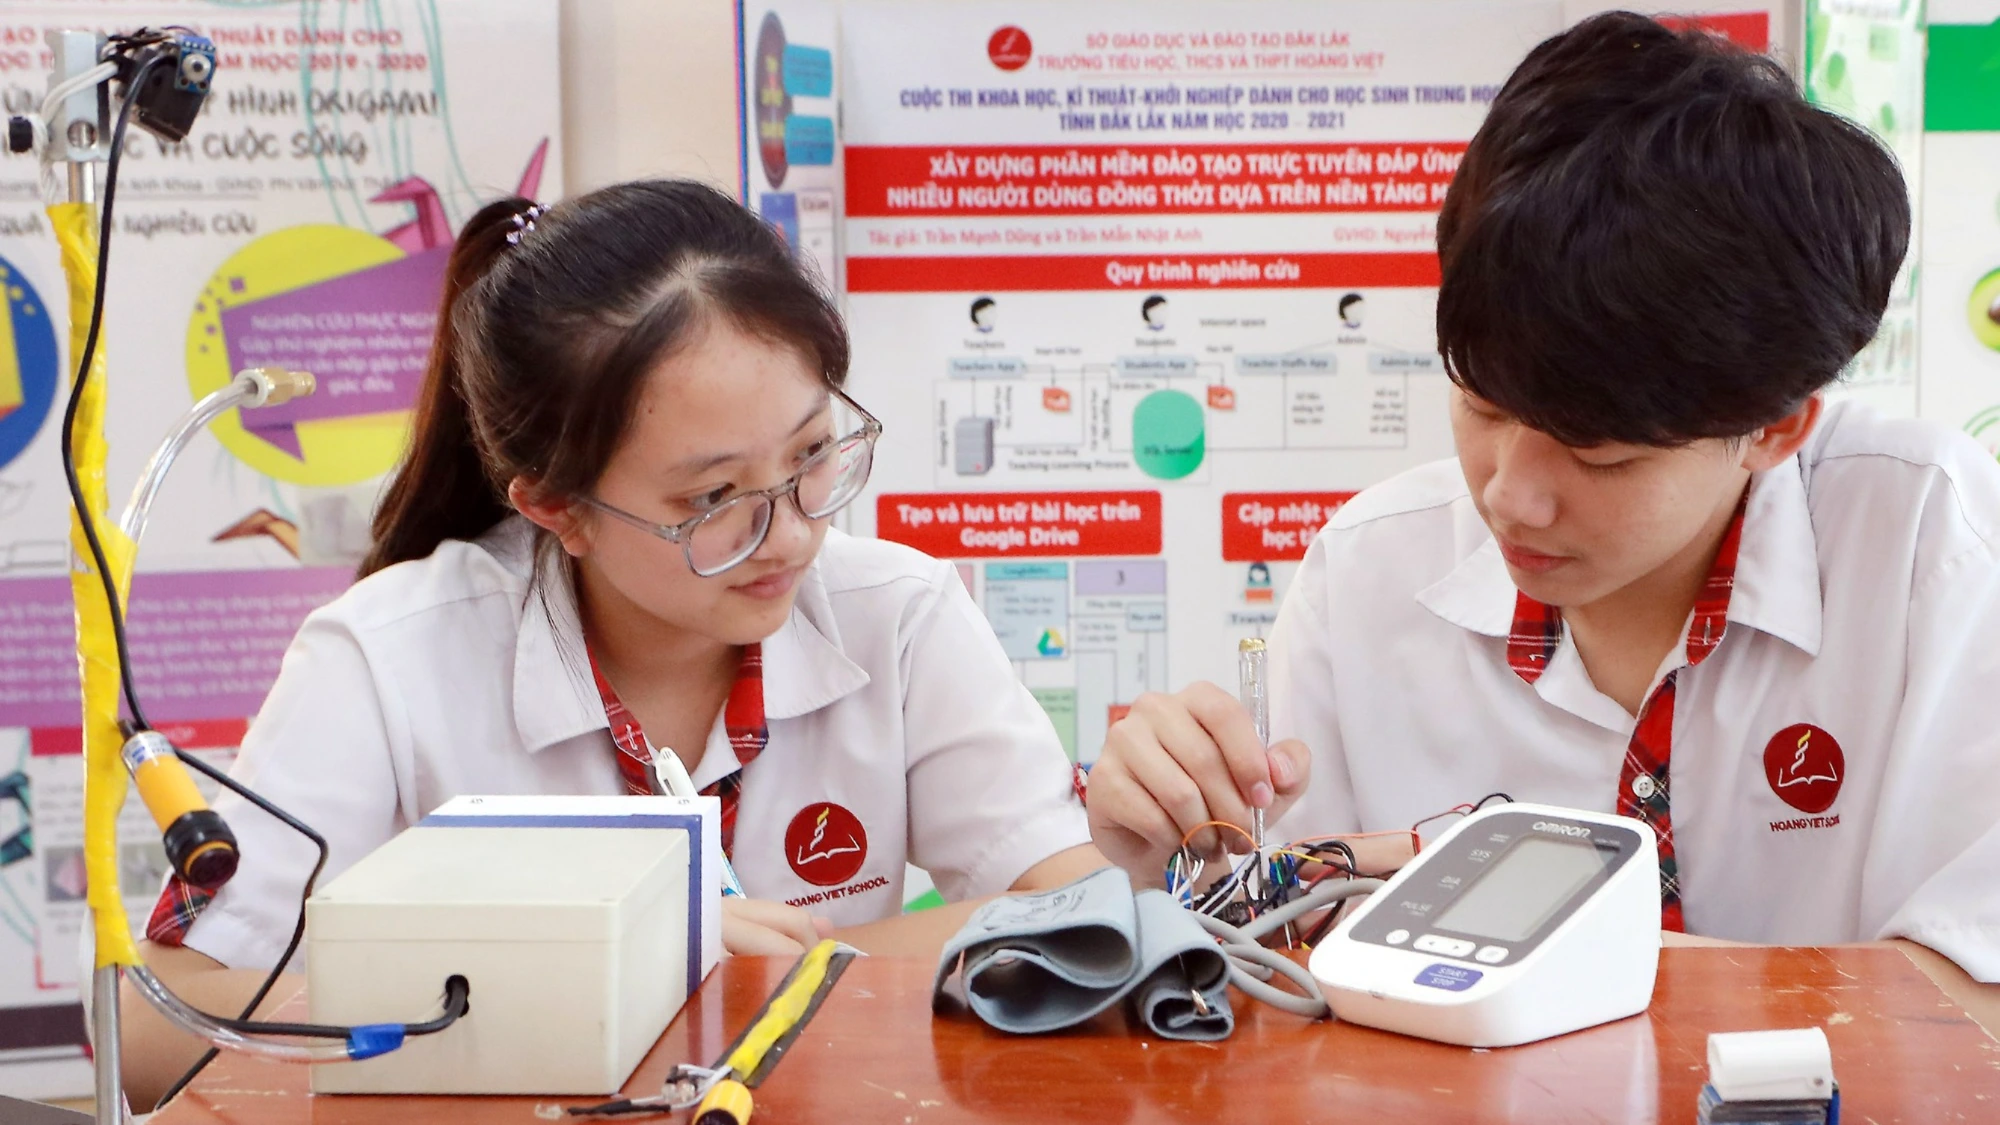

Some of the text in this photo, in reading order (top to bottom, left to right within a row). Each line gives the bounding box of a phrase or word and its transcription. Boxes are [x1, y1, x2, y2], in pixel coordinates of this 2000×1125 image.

[352, 28, 403, 45] CHO
[308, 52, 357, 71] 2019
[376, 52, 427, 71] 2020
[1186, 53, 1224, 69] THCS
[1254, 53, 1290, 68] THPT
[949, 89, 972, 106] THI
[978, 89, 1019, 106] KHOA
[1299, 86, 1329, 104] CHO
[1371, 86, 1409, 103] SINH
[1415, 85, 1466, 103] TRUNG
[1251, 112, 1289, 129] 2020
[1308, 111, 1344, 129] 2021
[929, 150, 970, 178] XÂY
[975, 153, 1035, 182] DỰNG
[1040, 149, 1096, 177] PHẦN
[1101, 148, 1149, 177] MỀM
[1152, 148, 1198, 176] ĐÀO
[1201, 153, 1243, 180] TẠO
[1247, 151, 1302, 179] TRỰC
[1305, 147, 1373, 175] TUYẾN
[1376, 147, 1419, 174] ĐÁP
[887, 176, 1427, 210] NHIỀU NGƯỜI DÙNG ĐỒNG THỜI DỰA TRÊN NỀN TẢNG
[1105, 257, 1300, 286] Quy trình nghiên cứu
[898, 500, 1142, 527] Tạo và lưu trữ bài học trên
[1238, 500, 1322, 527] Cập nhật
[960, 527, 1080, 550] Google Drive
[1262, 528, 1297, 551] học
[1532, 821, 1592, 840] OMRON
[1769, 818, 1807, 832] HOANG
[1806, 817, 1825, 828] VIET
[1469, 848, 1492, 860] SYS
[823, 887, 848, 901] VIET
[847, 875, 890, 896] SCHOOL
[1399, 901, 1434, 914] PULSE
[1430, 976, 1456, 988] STOP
